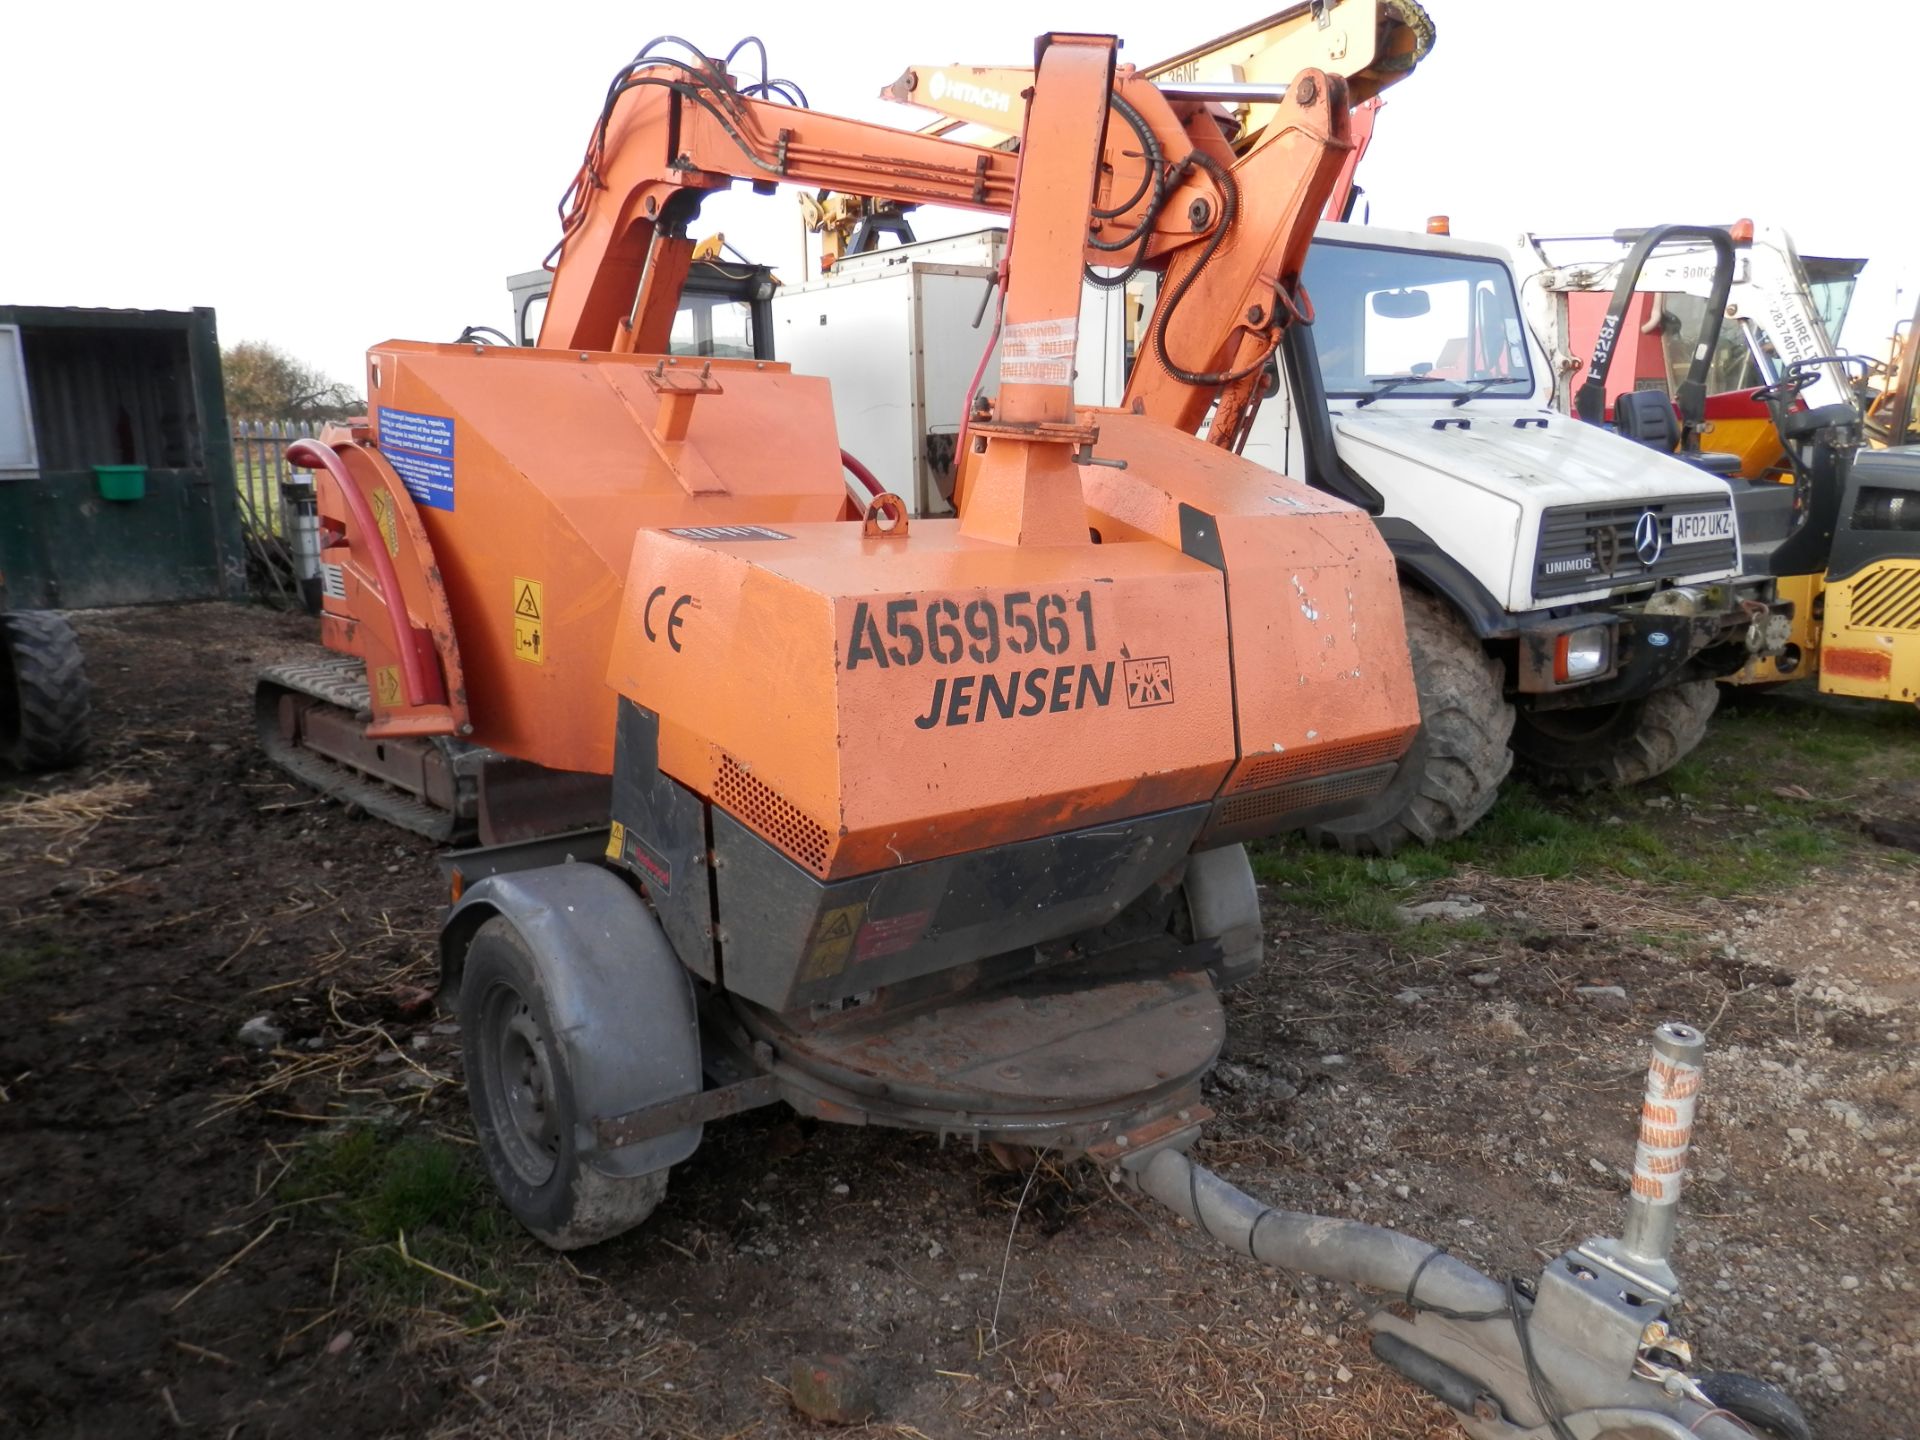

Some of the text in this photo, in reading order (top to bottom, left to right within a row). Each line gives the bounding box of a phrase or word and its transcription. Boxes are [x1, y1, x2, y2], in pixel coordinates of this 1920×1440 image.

[945, 79, 1010, 113] HITACHI
[1790, 313, 1811, 346] HIRE
[1588, 314, 1620, 380] F 3284
[1676, 513, 1729, 538] AF02 UKZ
[1545, 558, 1592, 575] UNIMOG
[846, 589, 1097, 670] A569561
[914, 661, 1116, 730] JENSEN
